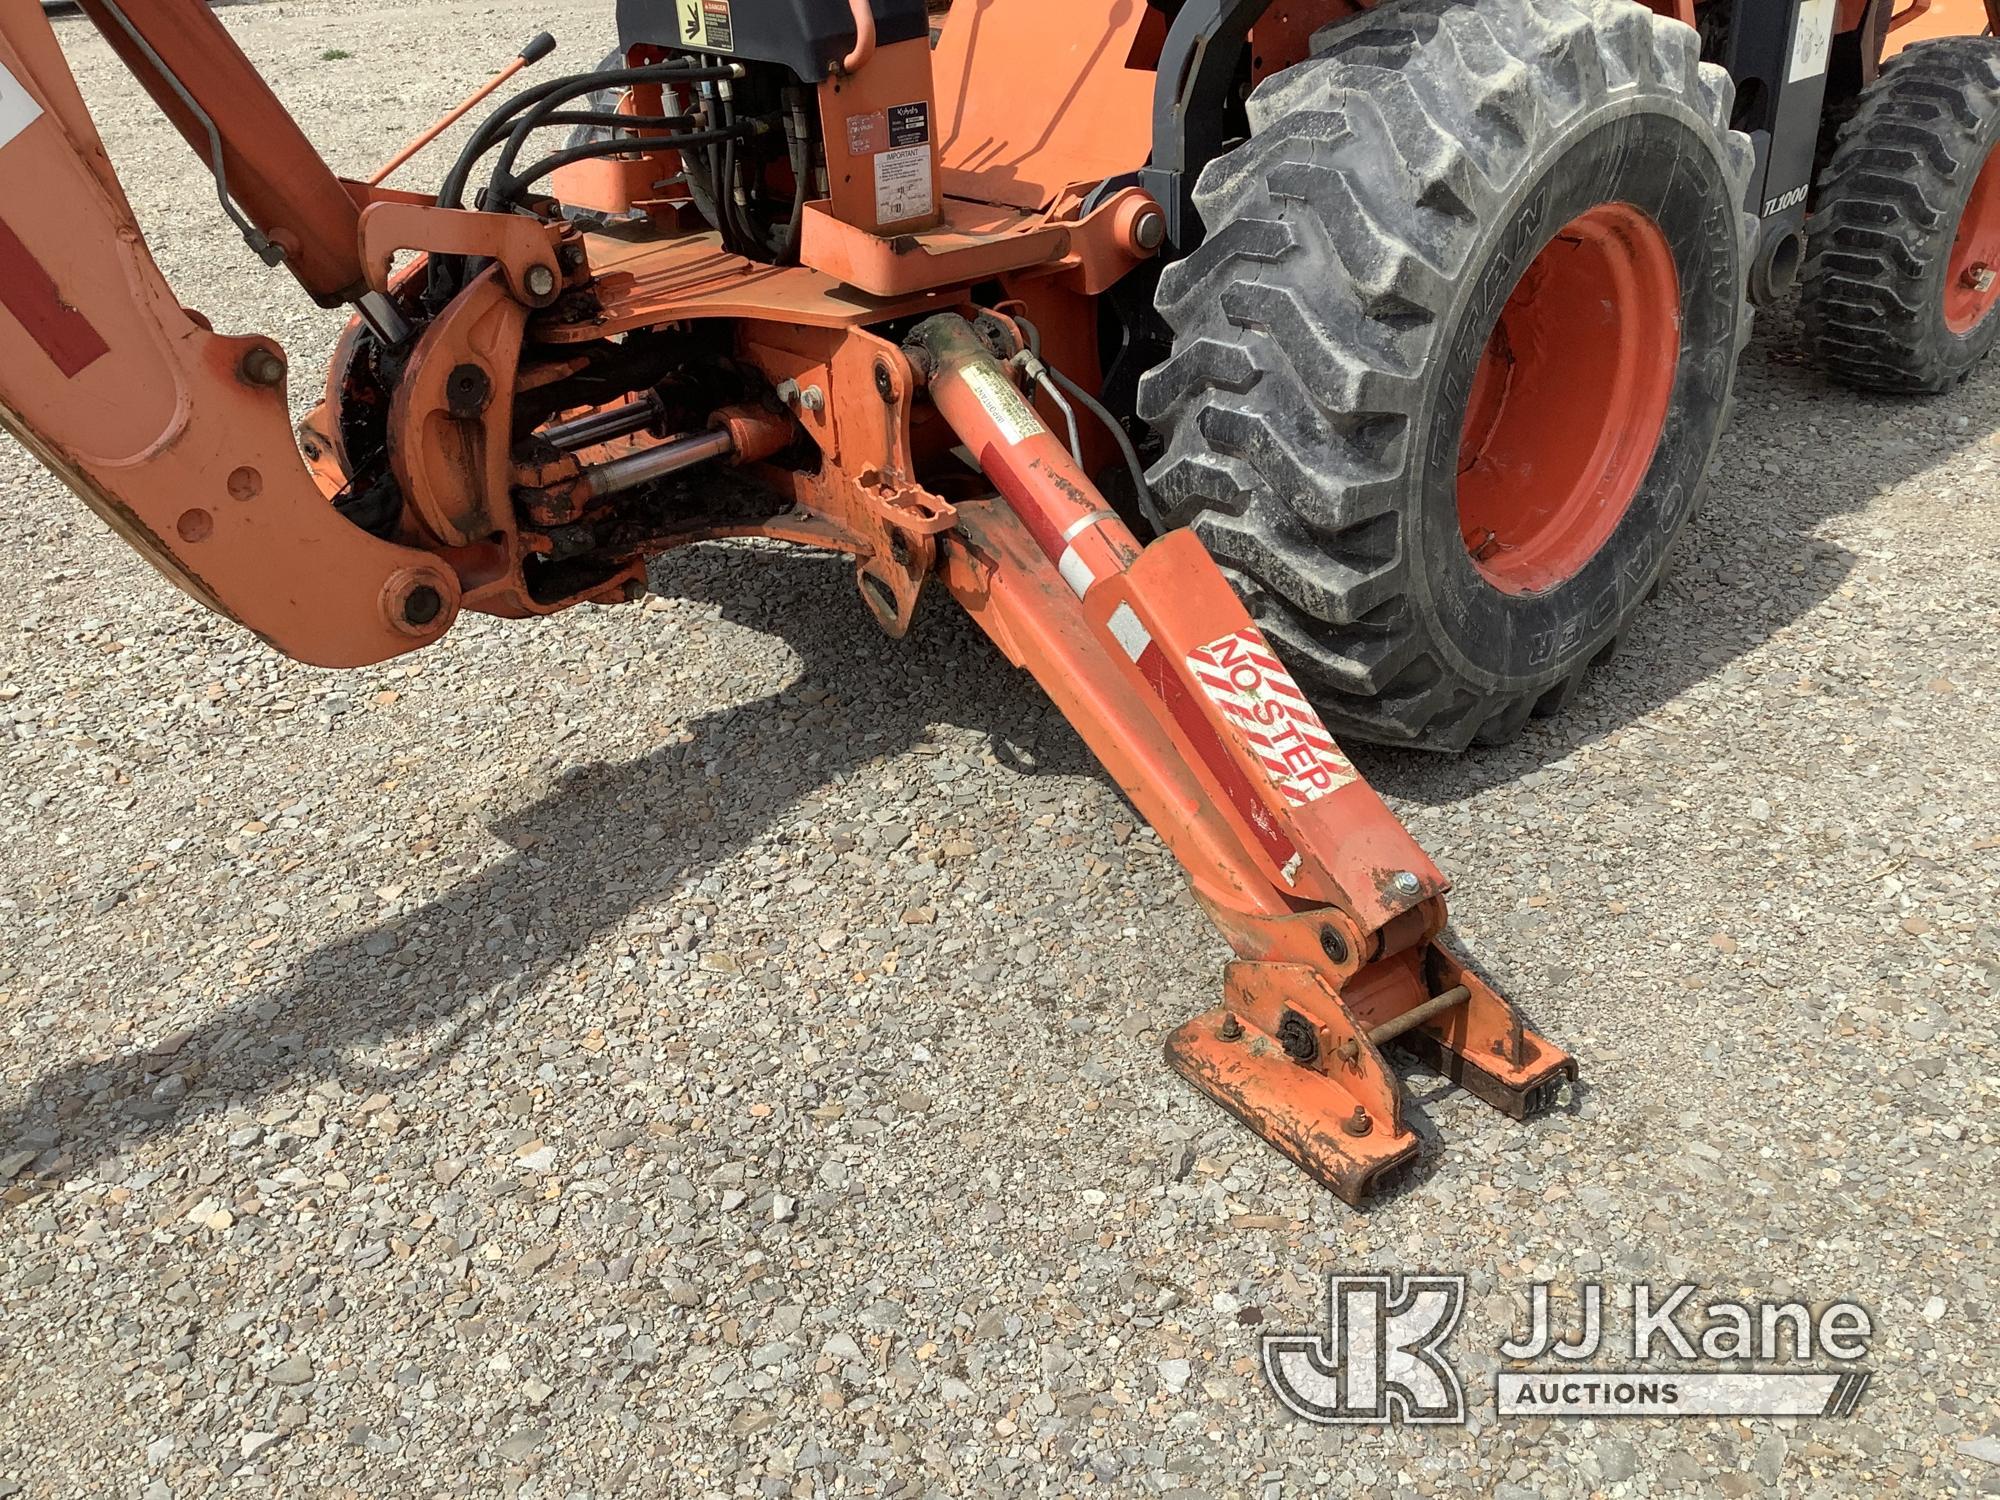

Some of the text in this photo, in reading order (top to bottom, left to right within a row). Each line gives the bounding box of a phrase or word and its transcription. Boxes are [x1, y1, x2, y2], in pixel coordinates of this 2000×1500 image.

[896, 106, 919, 116] Kubota
[886, 149, 919, 160] IMPORTANT
[1763, 183, 1809, 218] TL1000
[1431, 187, 1546, 472] TITAN
[975, 387, 1005, 424] IMPORTANT
[1211, 638, 1332, 789] NO STEP
